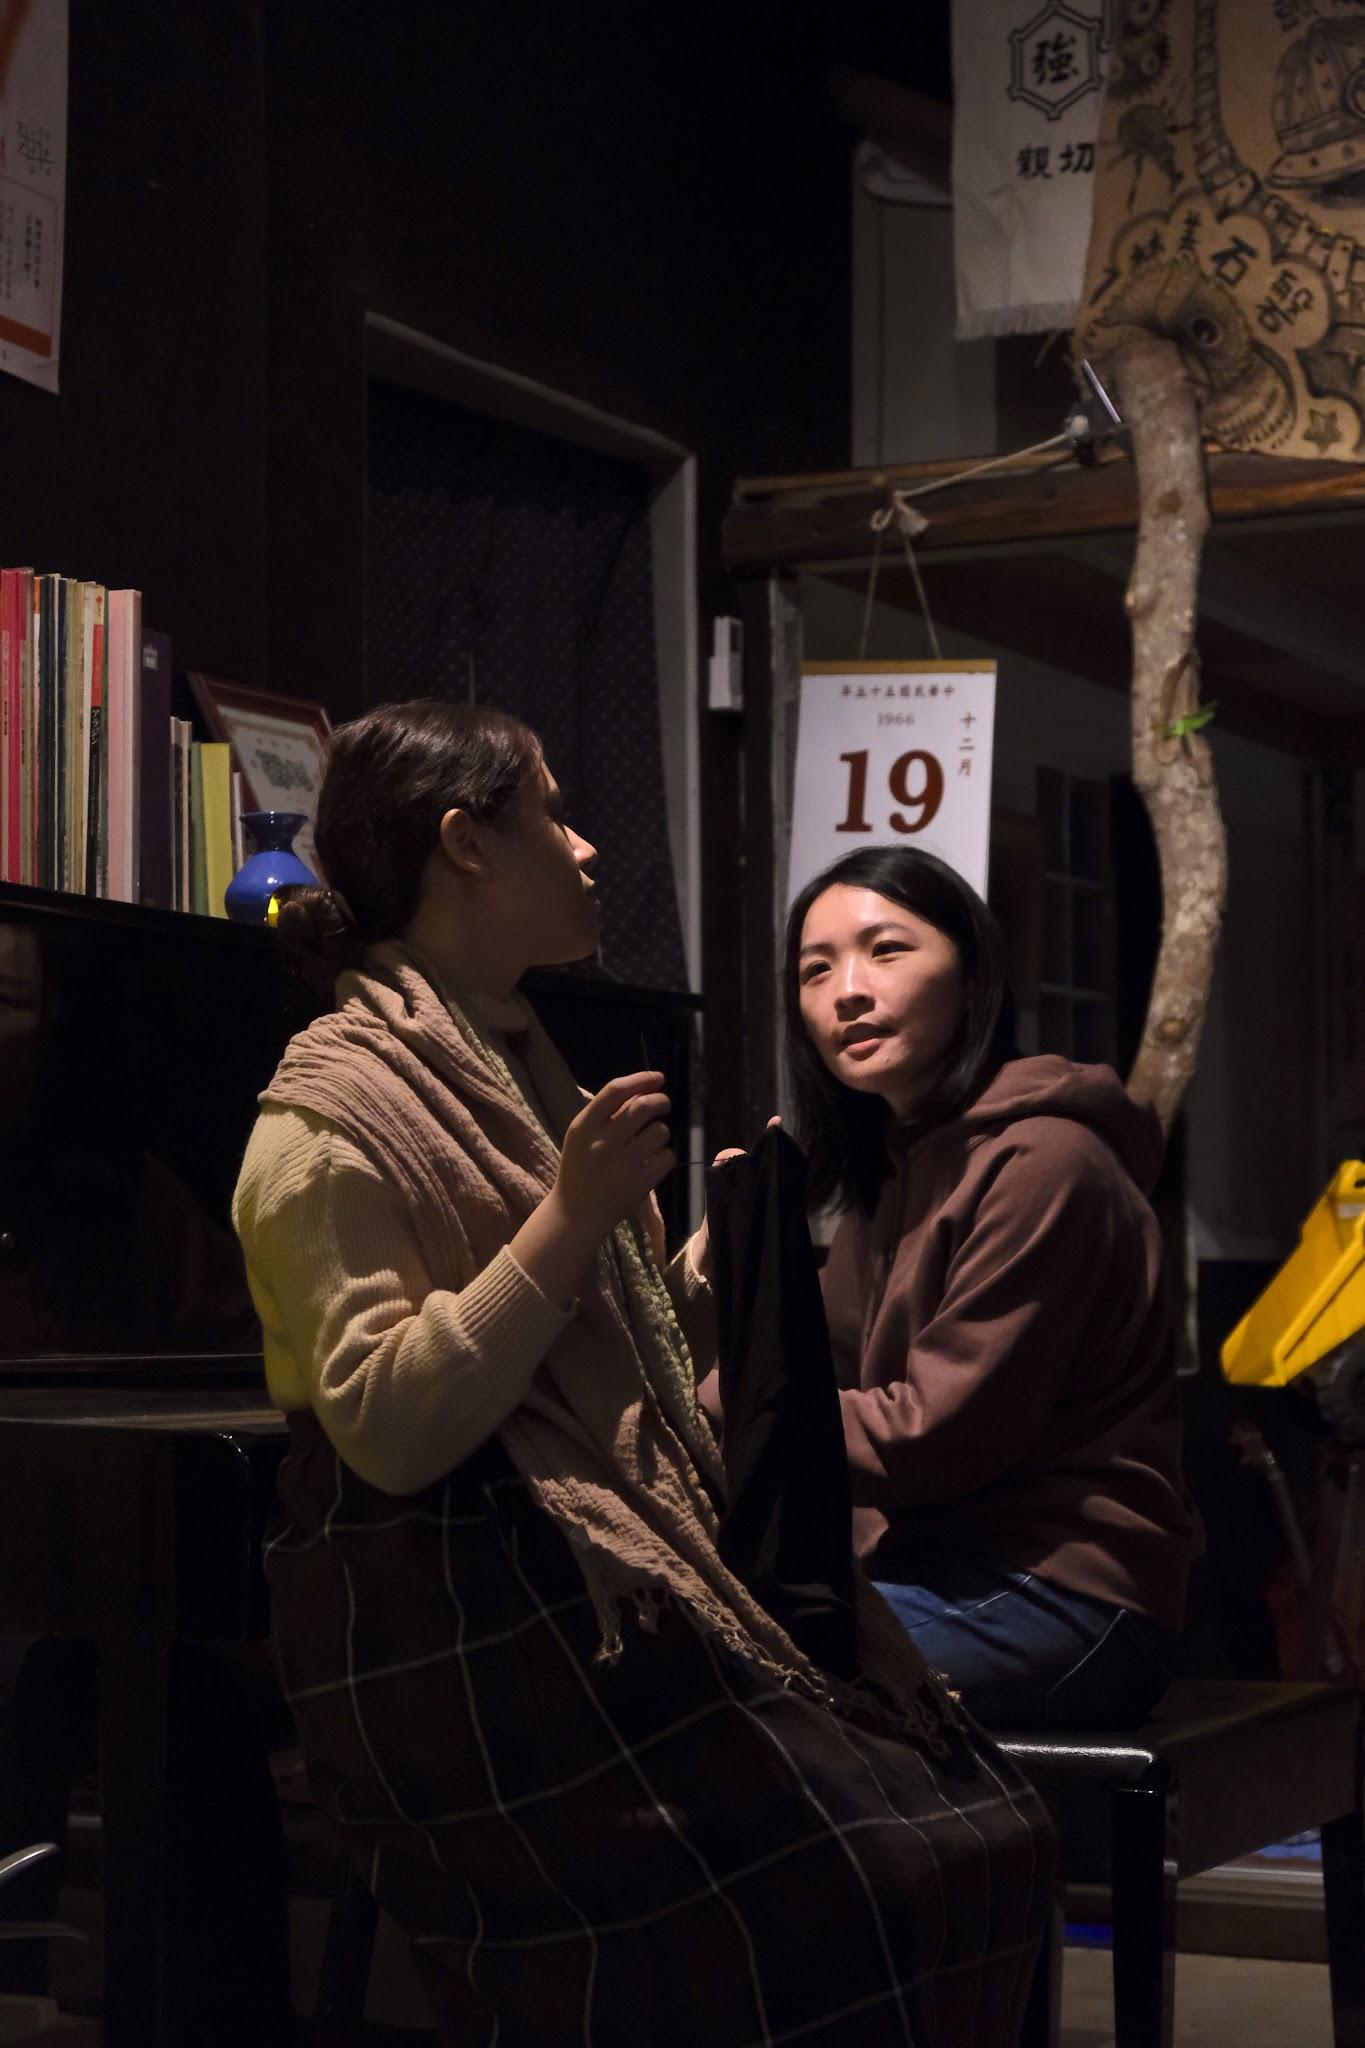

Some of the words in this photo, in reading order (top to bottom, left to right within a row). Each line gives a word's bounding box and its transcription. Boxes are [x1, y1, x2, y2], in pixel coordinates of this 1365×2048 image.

[877, 712, 916, 727] 1966
[957, 711, 977, 777] 十二月
[834, 748, 945, 835] 19
